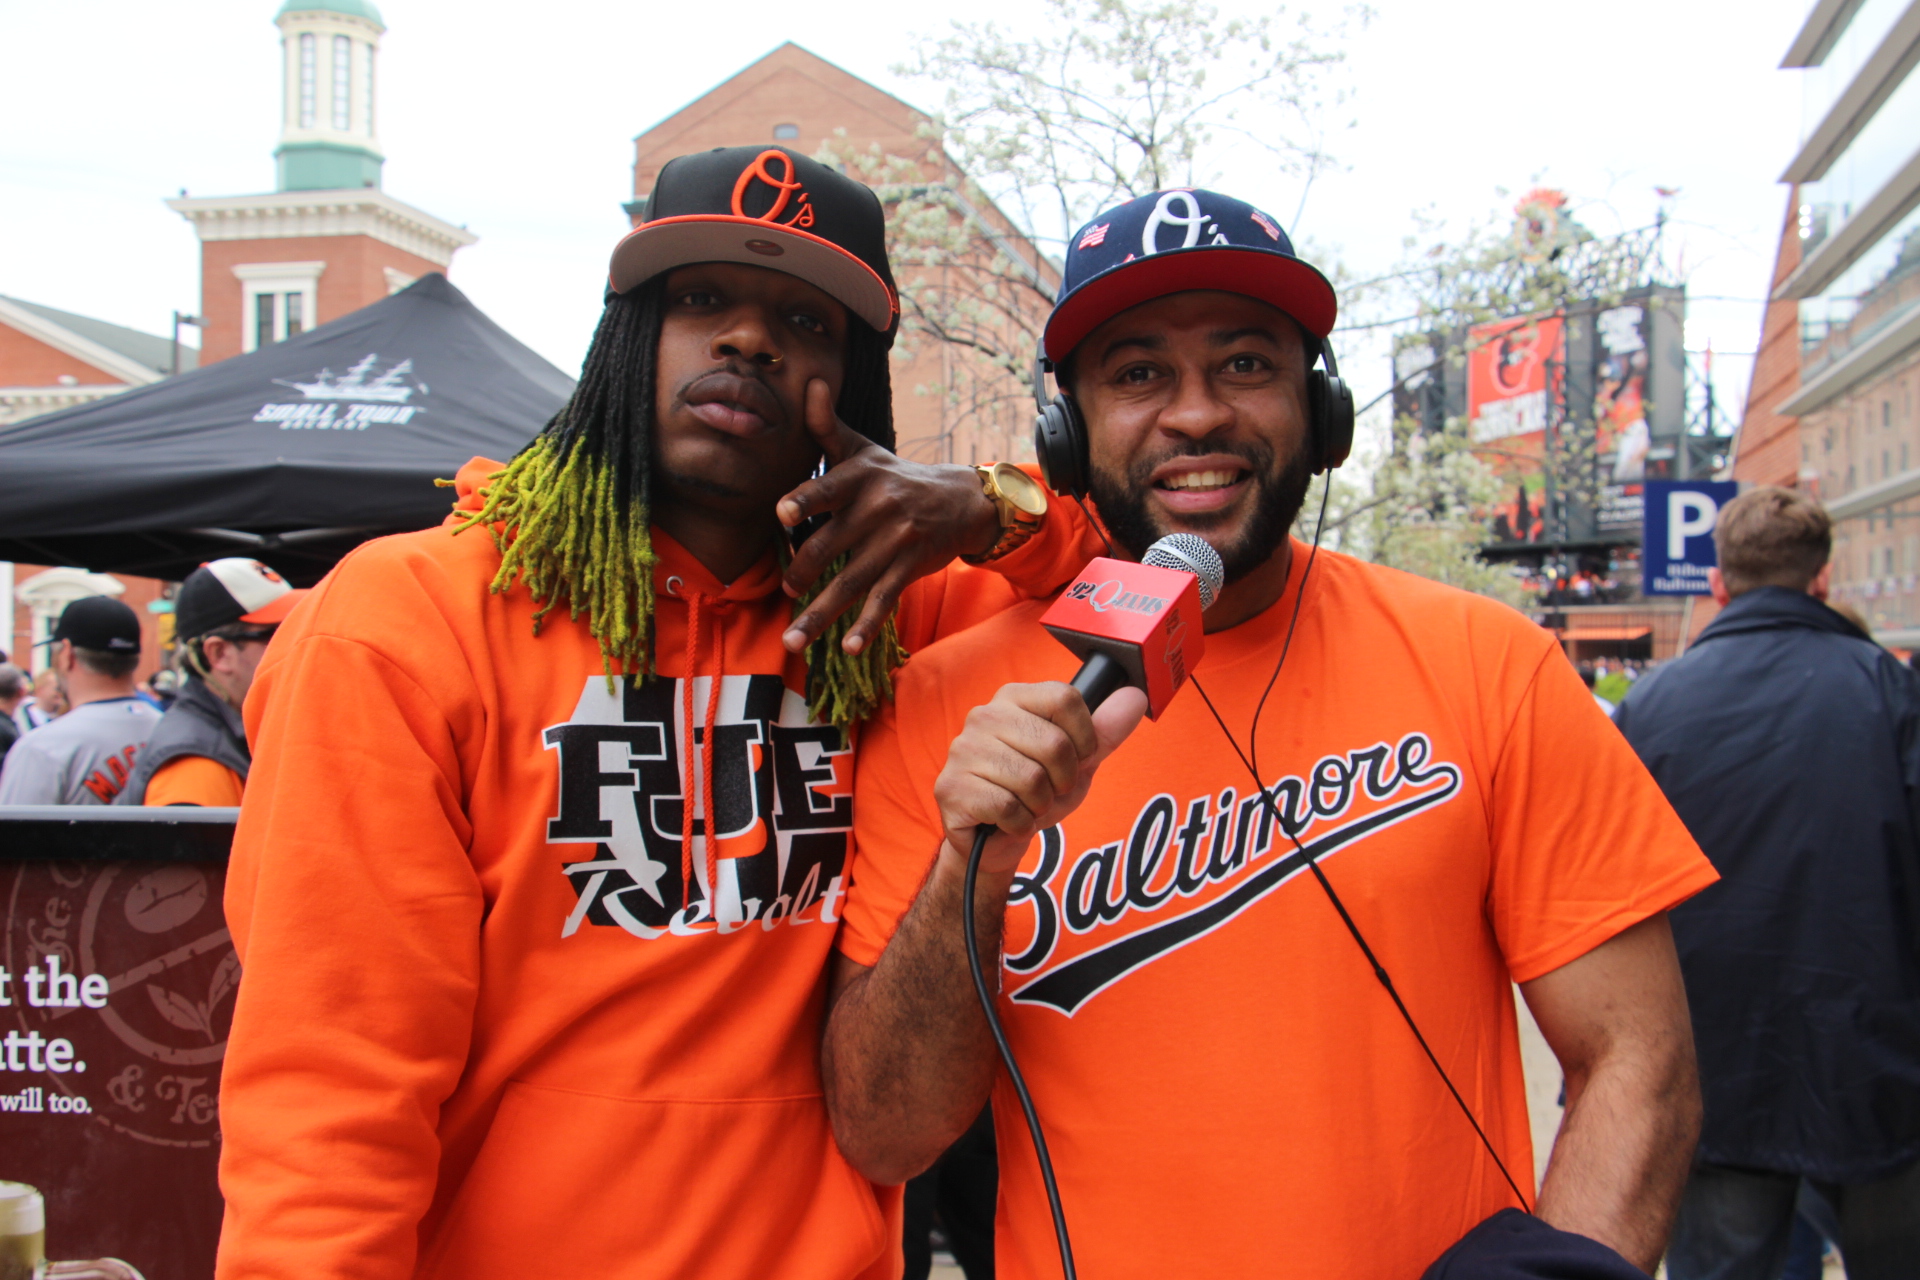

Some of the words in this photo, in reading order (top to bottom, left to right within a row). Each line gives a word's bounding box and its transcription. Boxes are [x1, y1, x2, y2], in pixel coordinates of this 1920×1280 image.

[731, 149, 815, 228] O's
[1667, 490, 1718, 560] P
[84, 742, 147, 805] MAC
[1003, 731, 1455, 974] Baltimore
[24, 955, 108, 1008] the
[0, 1087, 43, 1112] will
[48, 1093, 92, 1113] too.
[155, 1075, 220, 1125] Te
